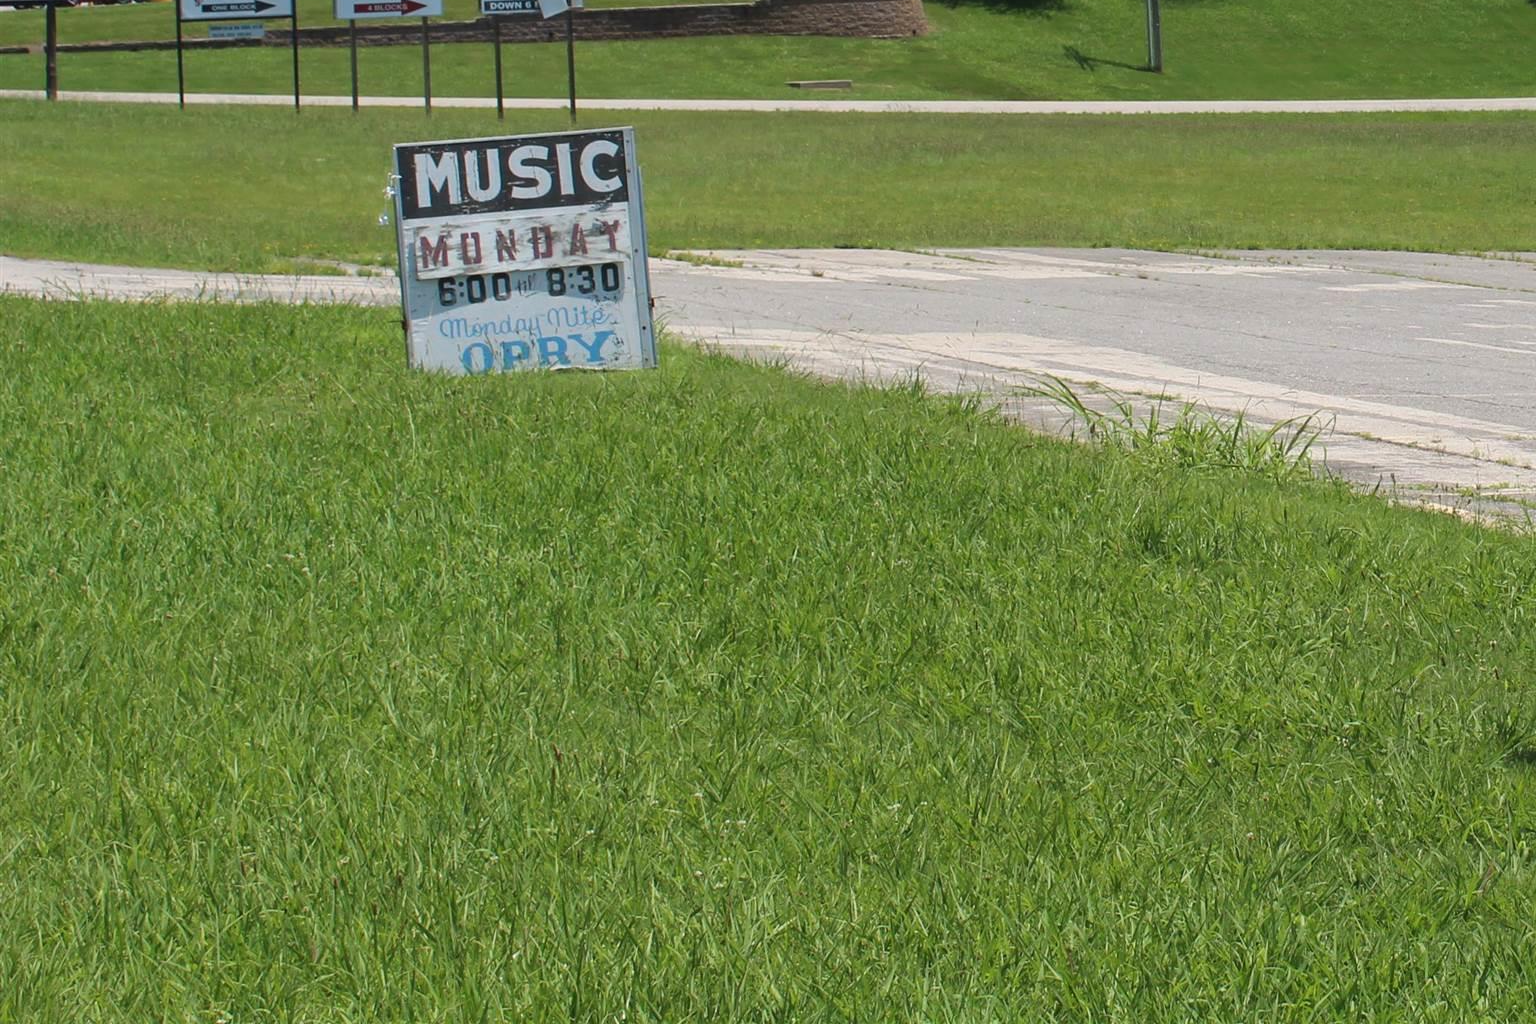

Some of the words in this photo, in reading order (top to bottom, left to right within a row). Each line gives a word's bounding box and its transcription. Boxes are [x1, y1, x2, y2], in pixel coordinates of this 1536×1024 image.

[489, 1, 522, 10] DOWN
[414, 139, 623, 209] MUSIC
[420, 219, 619, 268] MONDAY
[438, 272, 512, 306] 6:00
[546, 262, 620, 297] 8:30
[439, 310, 543, 342] Monday
[462, 330, 614, 374] OPRY
